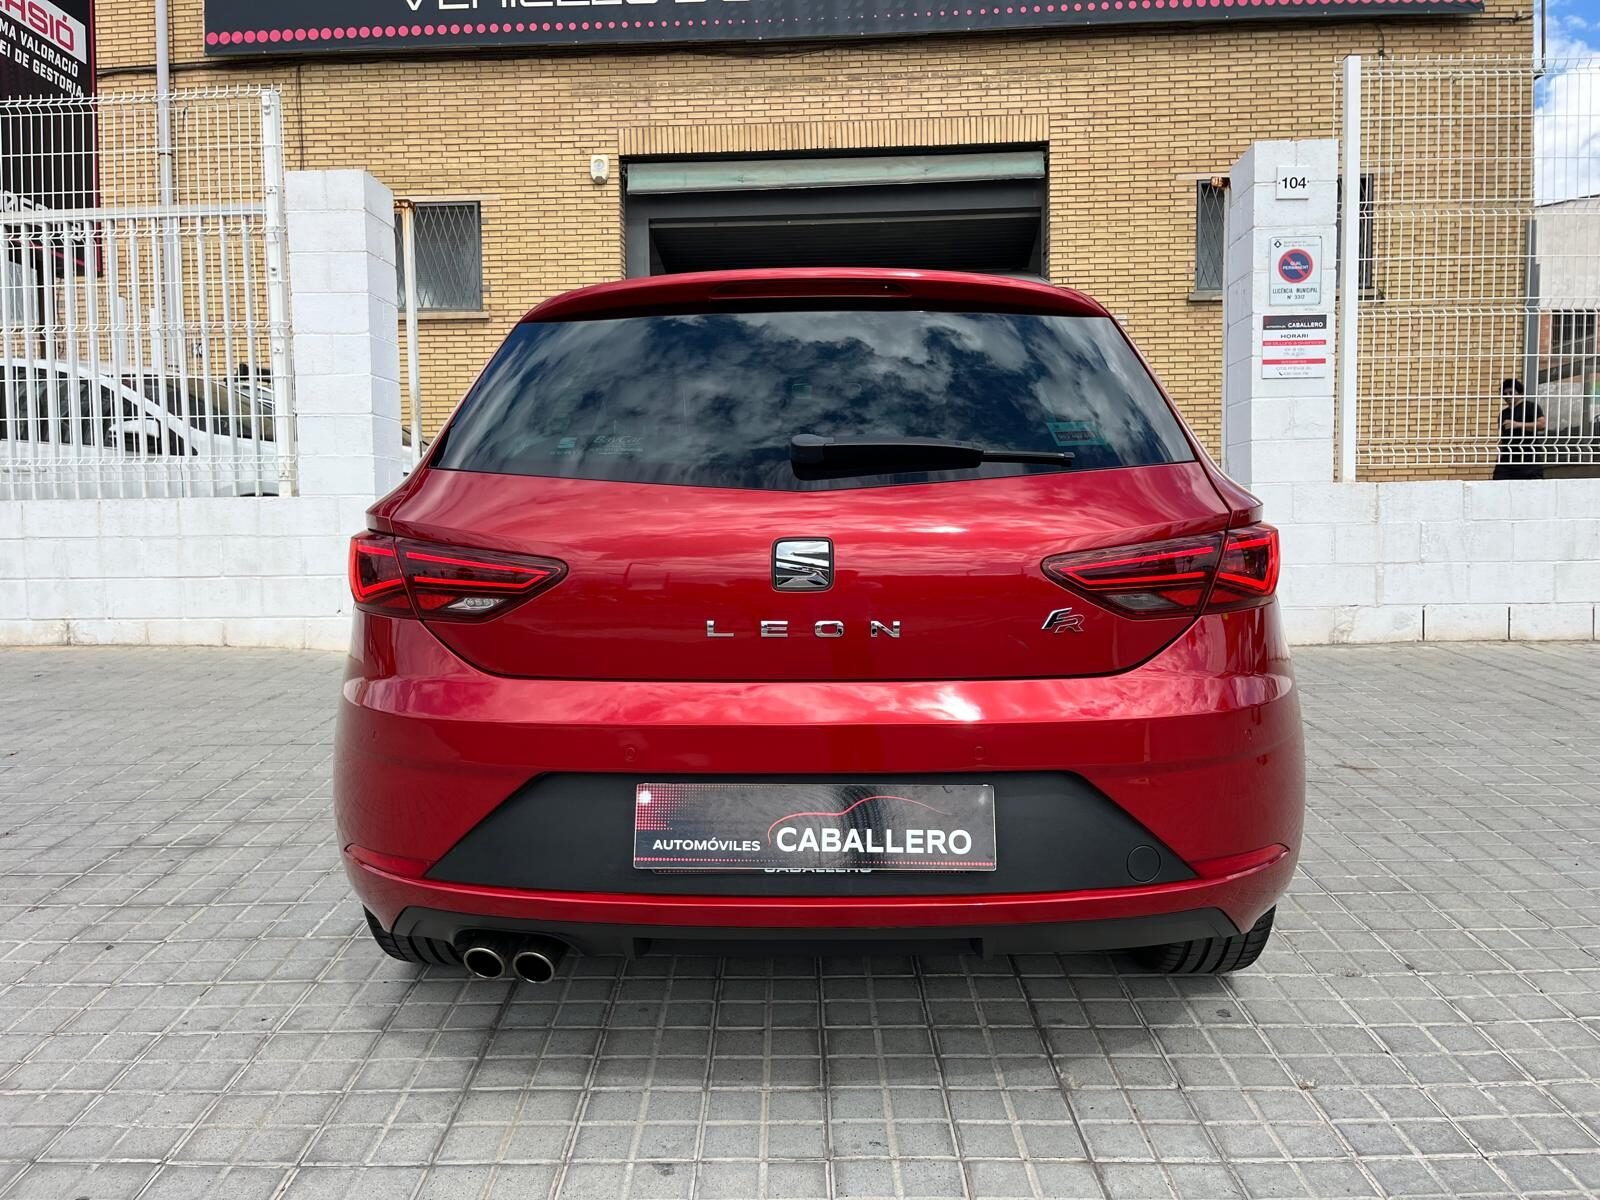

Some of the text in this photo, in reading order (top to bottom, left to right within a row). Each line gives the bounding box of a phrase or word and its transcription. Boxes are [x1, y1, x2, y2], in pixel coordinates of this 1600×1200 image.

[0, 0, 75, 52] ASIÓ
[20, 30, 79, 78] VALORACIÓ
[14, 47, 30, 69] DE
[32, 58, 82, 98] GESTORIA
[1281, 177, 1307, 189] 104
[1287, 321, 1324, 329] CABALLERO
[706, 619, 901, 638] LEON
[1041, 606, 1084, 634] FR
[652, 826, 973, 856] AUTOMÓVILES CABALLERO
